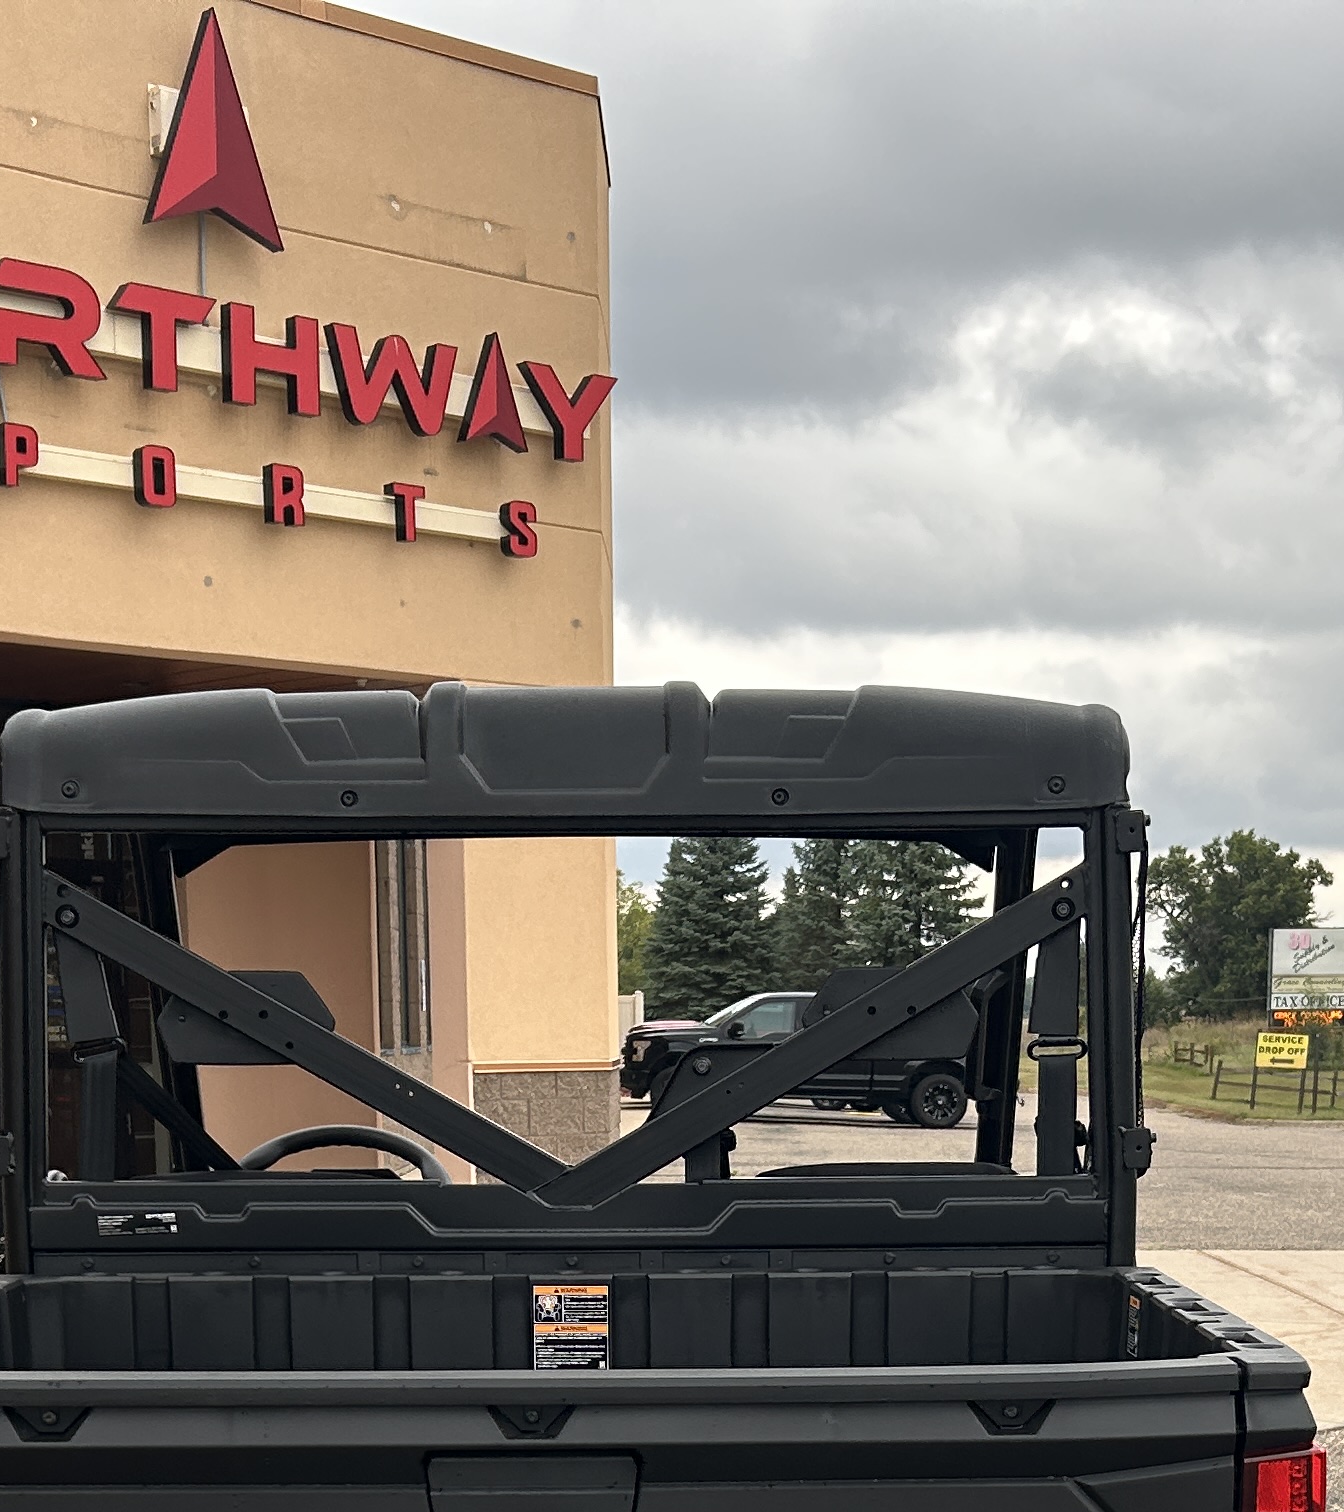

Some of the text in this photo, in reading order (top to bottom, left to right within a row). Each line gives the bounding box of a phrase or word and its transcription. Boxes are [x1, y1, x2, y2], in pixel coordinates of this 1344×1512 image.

[1273, 996, 1298, 1008] TAX
[1262, 1035, 1304, 1045] SERVICE
[1258, 1046, 1306, 1056] DROP OFF
